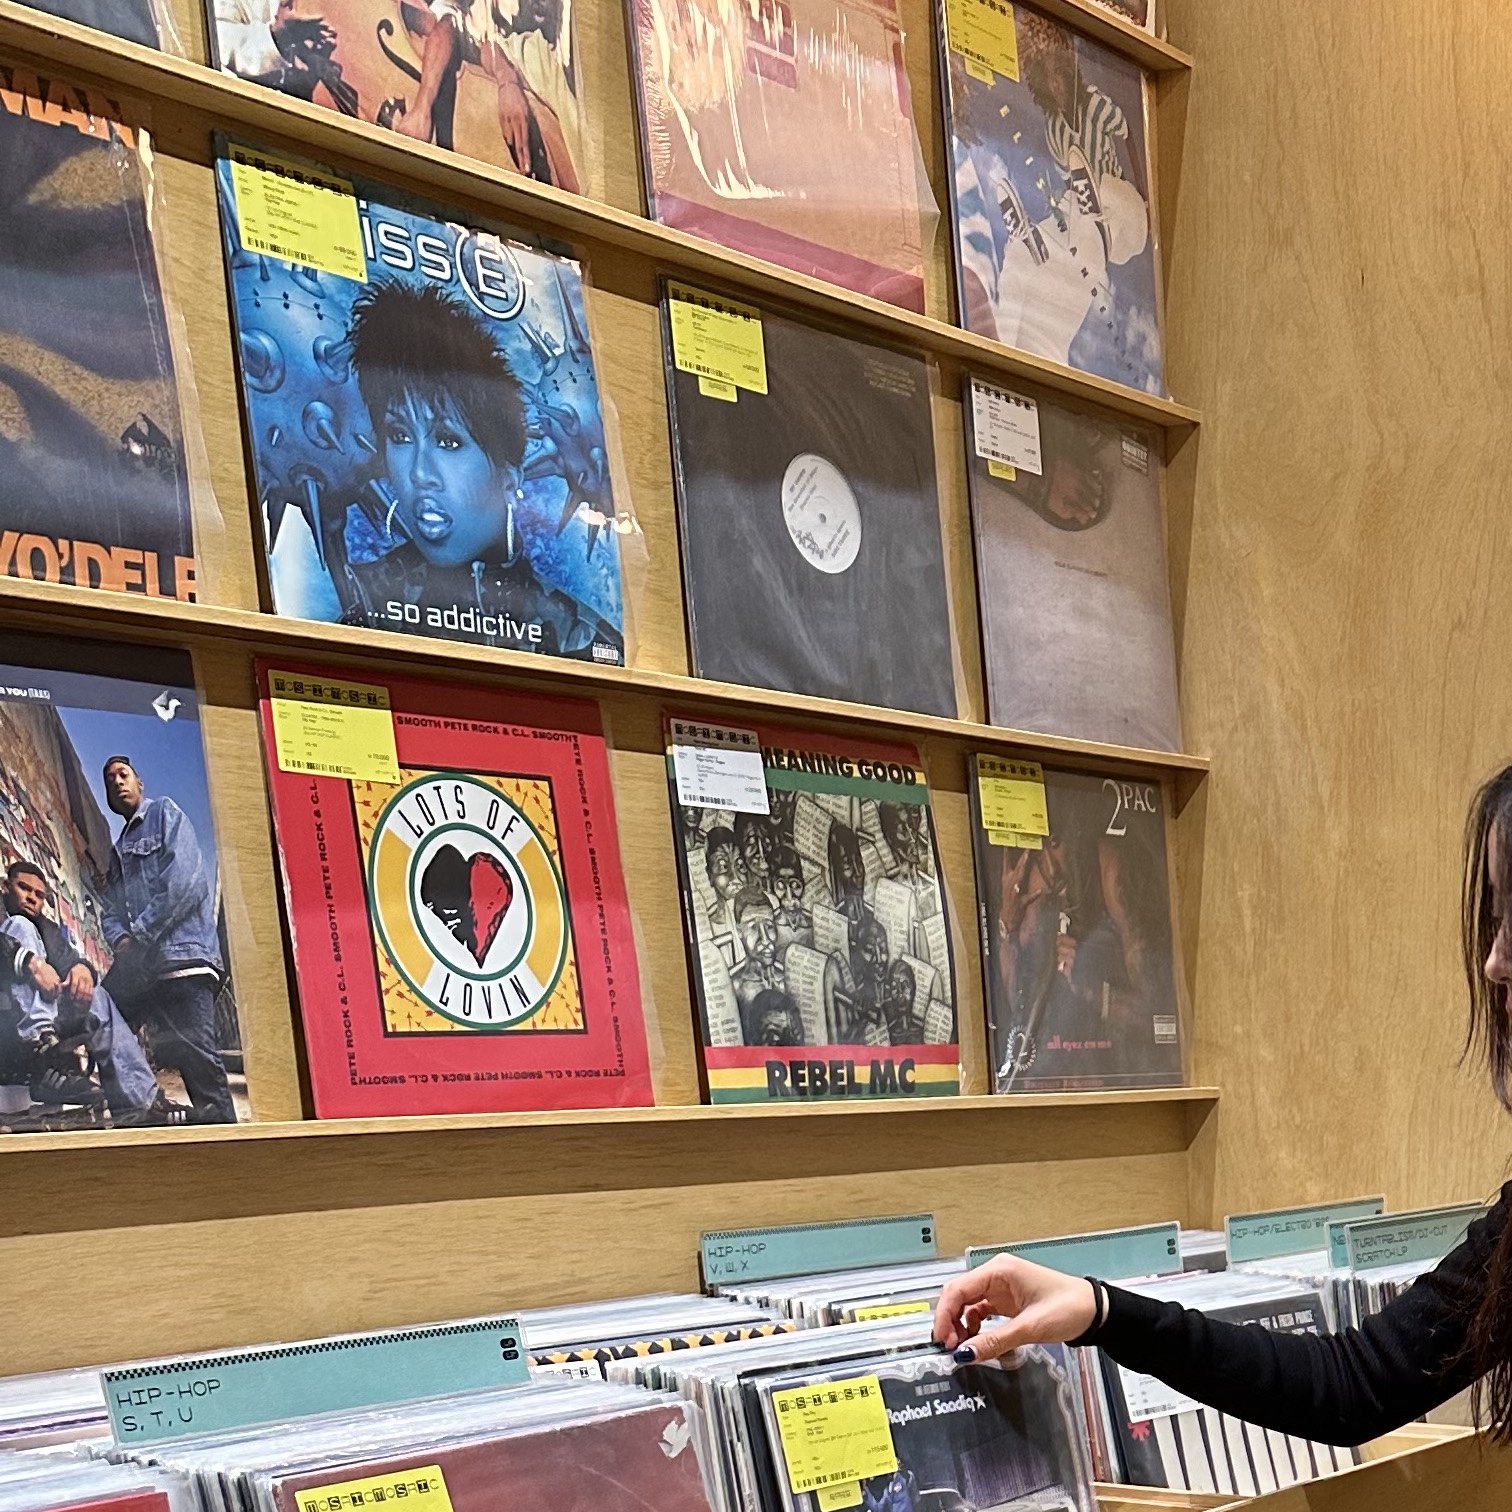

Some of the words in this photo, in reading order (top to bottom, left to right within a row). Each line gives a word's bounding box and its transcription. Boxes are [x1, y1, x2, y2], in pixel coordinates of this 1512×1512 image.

[427, 605, 542, 643] addictive
[396, 715, 442, 729] SMOOTH
[443, 720, 470, 732] PETE
[471, 723, 500, 735] ROCK
[857, 758, 917, 786] GOOD
[398, 785, 467, 839] LOTS
[486, 798, 521, 841] OF
[1102, 778, 1157, 836] 2PAC
[315, 821, 329, 861] ROCK
[322, 865, 333, 900] PETE
[327, 904, 342, 962] SMOOTH
[438, 973, 531, 1019] LOVIN
[344, 1008, 354, 1049] ROCK
[765, 1059, 863, 1097] REBEL
[869, 1057, 916, 1094] MC
[708, 1242, 767, 1258] HIP-HOP
[741, 1260, 750, 1271] X
[116, 1378, 221, 1408] HIP-HOP
[933, 1394, 976, 1416] Saadiq
[122, 1415, 145, 1432] S,
[150, 1410, 173, 1427] T,
[177, 1406, 194, 1423] U
